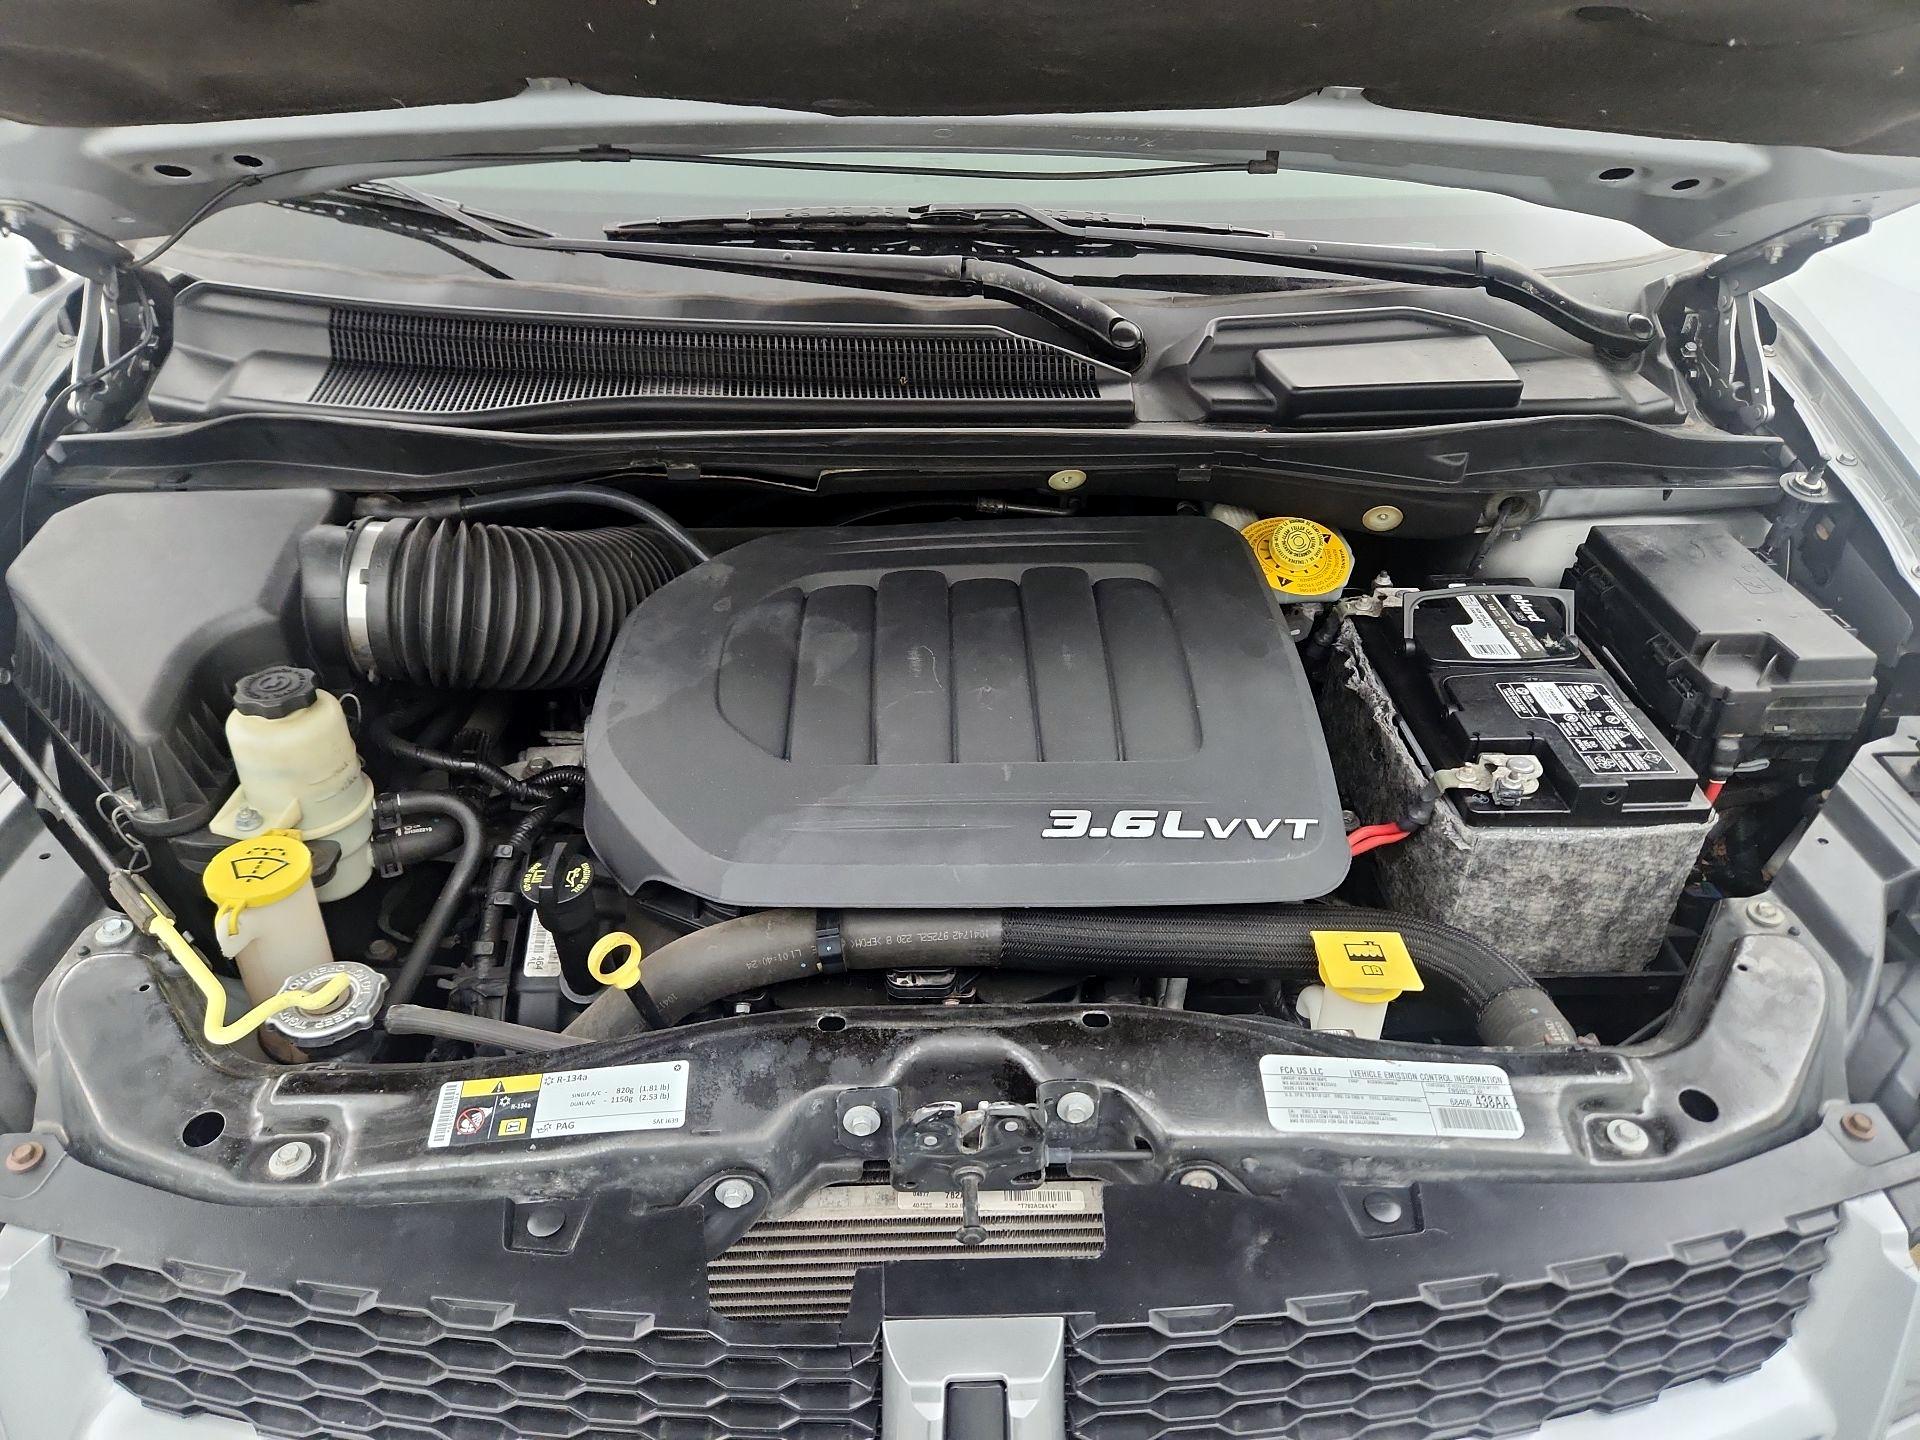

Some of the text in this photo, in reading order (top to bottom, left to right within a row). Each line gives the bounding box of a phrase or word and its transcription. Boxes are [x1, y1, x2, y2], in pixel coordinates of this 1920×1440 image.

[1041, 809, 1320, 841] 3.6L VVT
[571, 883, 585, 893] OIL
[315, 1009, 354, 1029] KEEP
[1280, 1066, 1324, 1076] FCA US LLC
[1353, 1069, 1503, 1084] VEHICLE EMISSION CONTROL INFORMATION
[556, 1074, 588, 1084] R-134a
[616, 1087, 634, 1095] 820g
[639, 1084, 658, 1094] (1.81
[660, 1083, 670, 1093] lb)
[611, 1095, 634, 1104] 1150g
[639, 1093, 658, 1103] (2.53
[660, 1092, 670, 1101] lb)
[555, 1121, 576, 1131] PAG
[945, 1191, 963, 1199] 782
